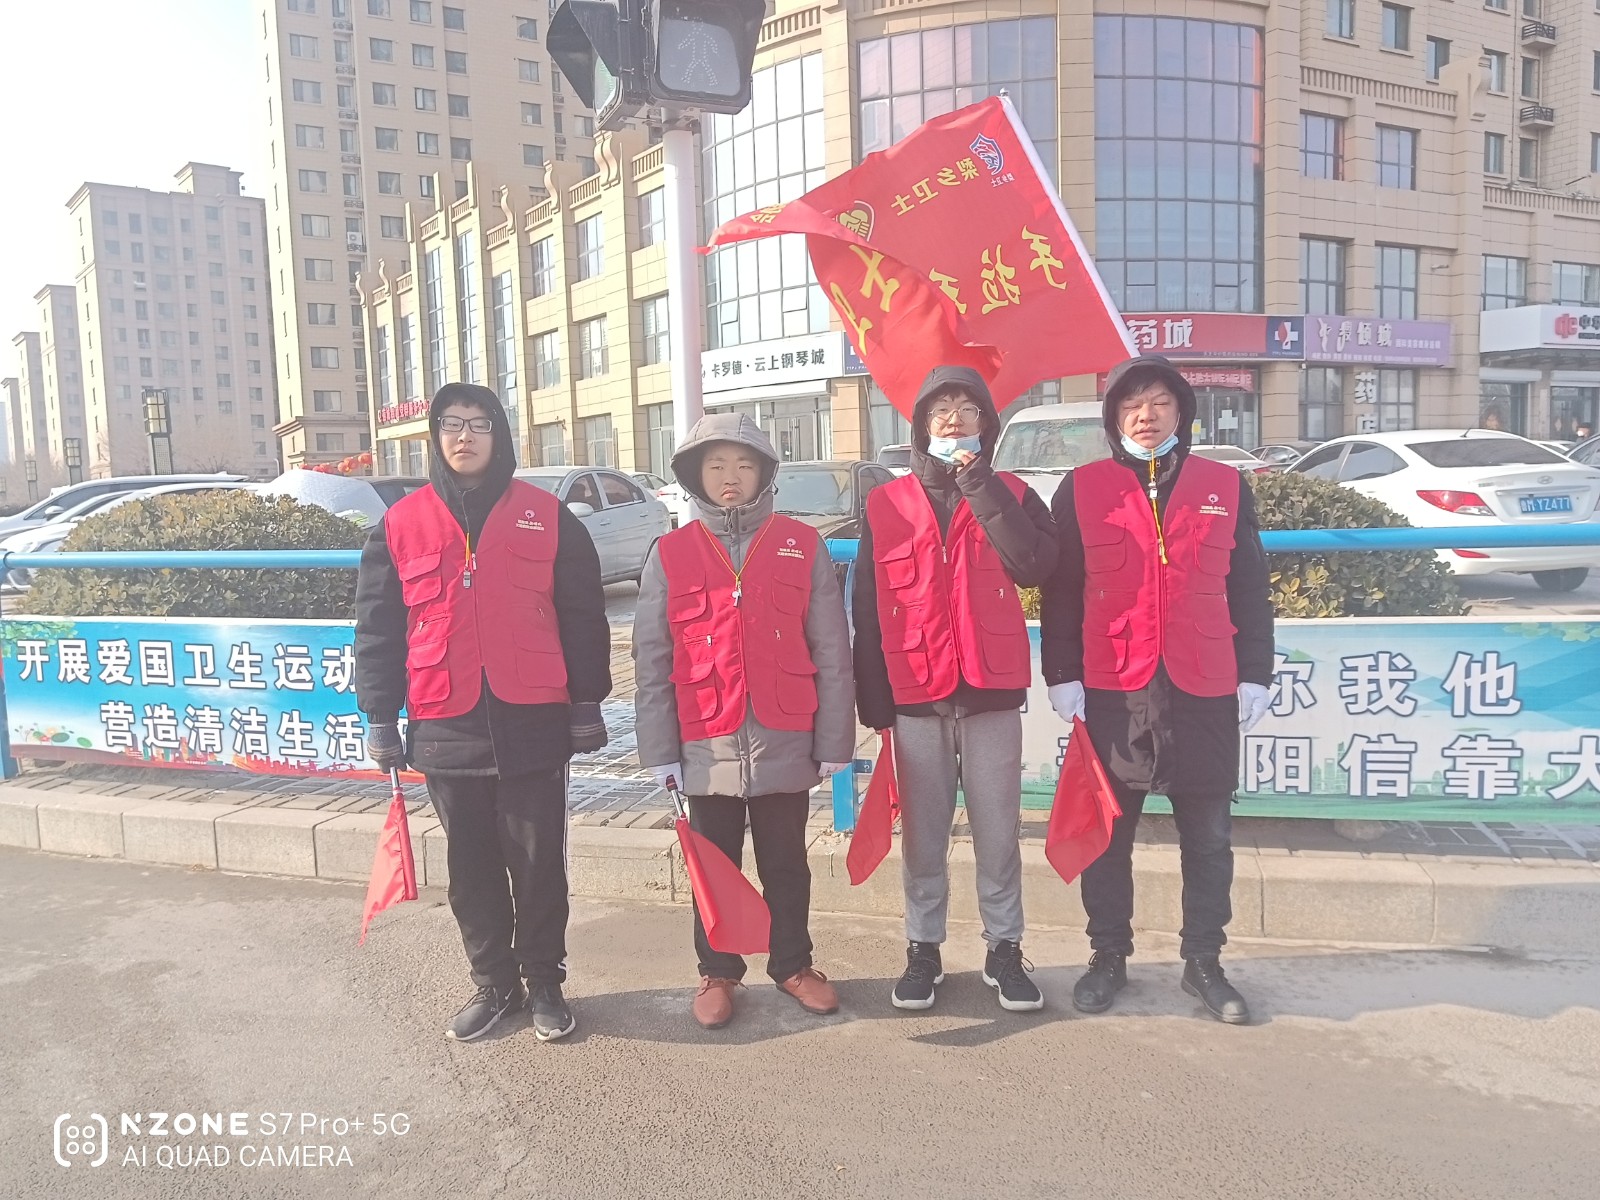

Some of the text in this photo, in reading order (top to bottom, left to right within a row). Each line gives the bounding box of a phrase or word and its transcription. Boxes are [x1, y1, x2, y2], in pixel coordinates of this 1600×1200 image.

[1126, 318, 1193, 349] 药城
[16, 639, 356, 694] 开展爱国卫生运动
